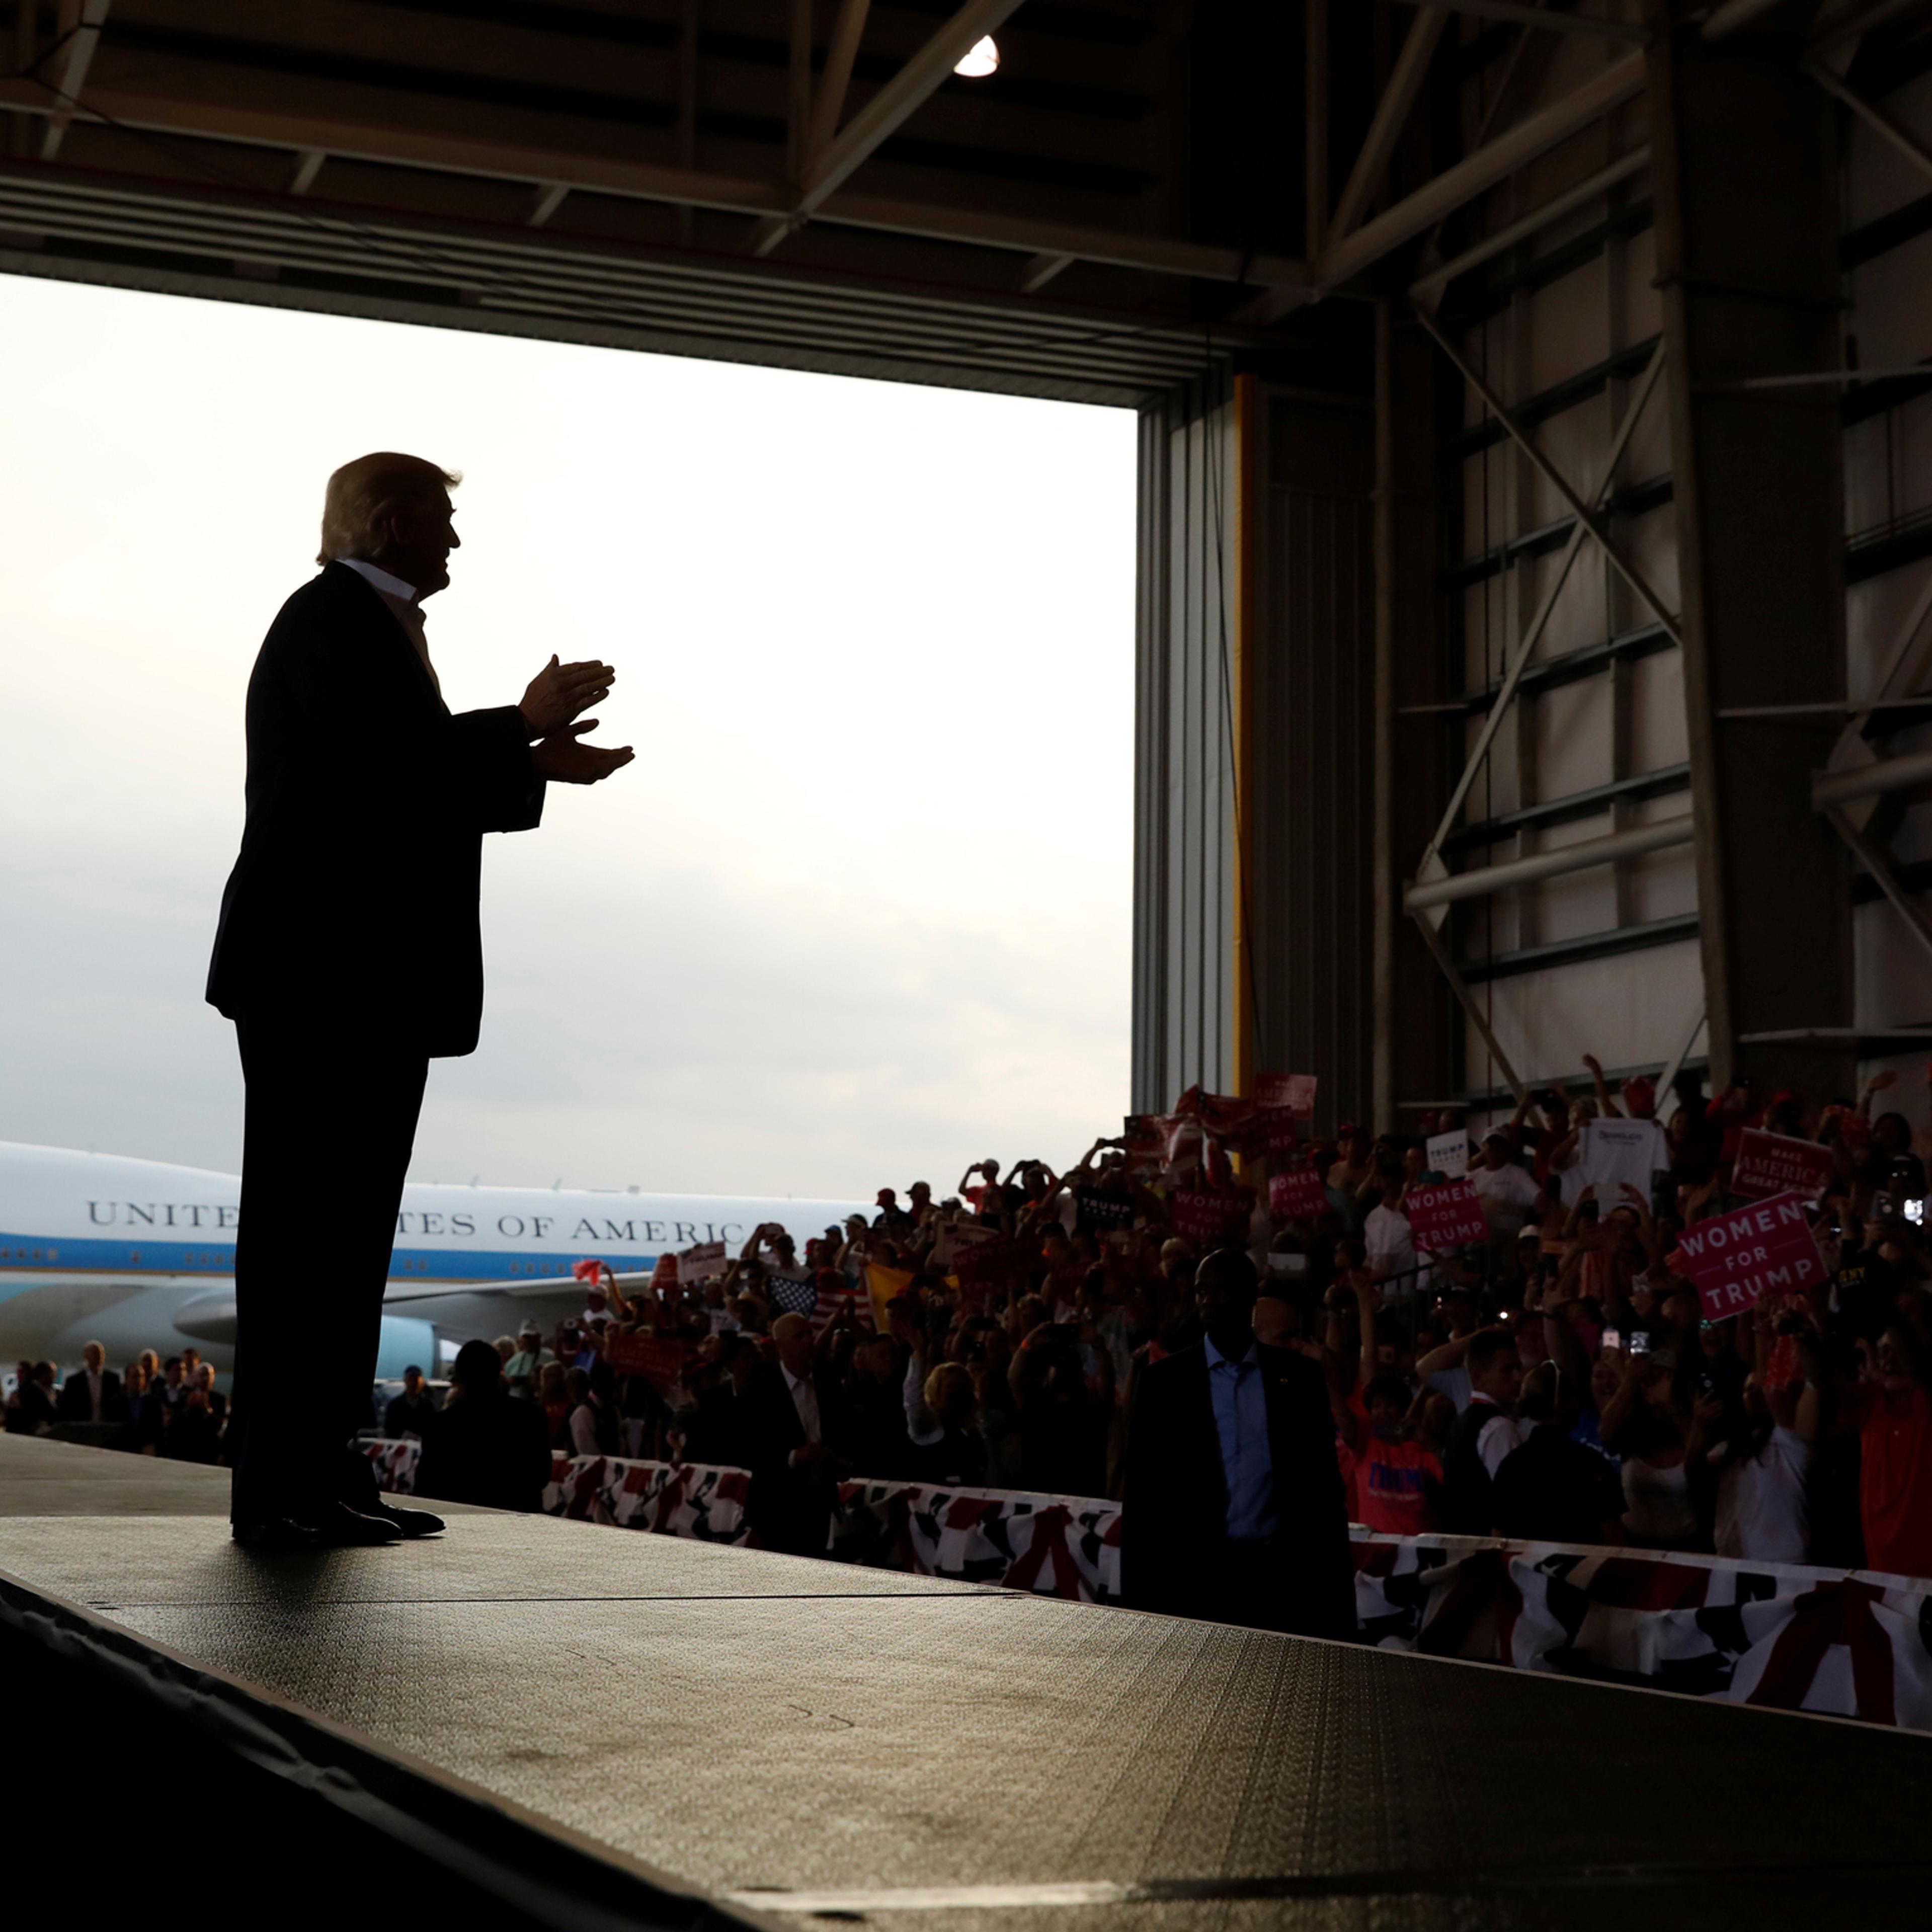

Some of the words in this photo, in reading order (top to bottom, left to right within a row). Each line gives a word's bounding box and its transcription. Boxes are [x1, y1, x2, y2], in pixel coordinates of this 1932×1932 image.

[1740, 1155, 1828, 1186] AMERICA
[1082, 1197, 1131, 1213] TRUMP
[1176, 1191, 1248, 1212] WOMEN
[1406, 1183, 1477, 1211] WOMEN
[88, 1200, 239, 1228] UNITE
[398, 1212, 476, 1236] TES
[498, 1215, 554, 1238] OF
[571, 1218, 744, 1245] AMERIC
[1431, 1209, 1457, 1223] FOR
[1679, 1200, 1802, 1257] WOMEN
[1417, 1221, 1483, 1246] TRUMP
[1724, 1246, 1768, 1271] FOR
[1705, 1258, 1812, 1310] TRUMP
